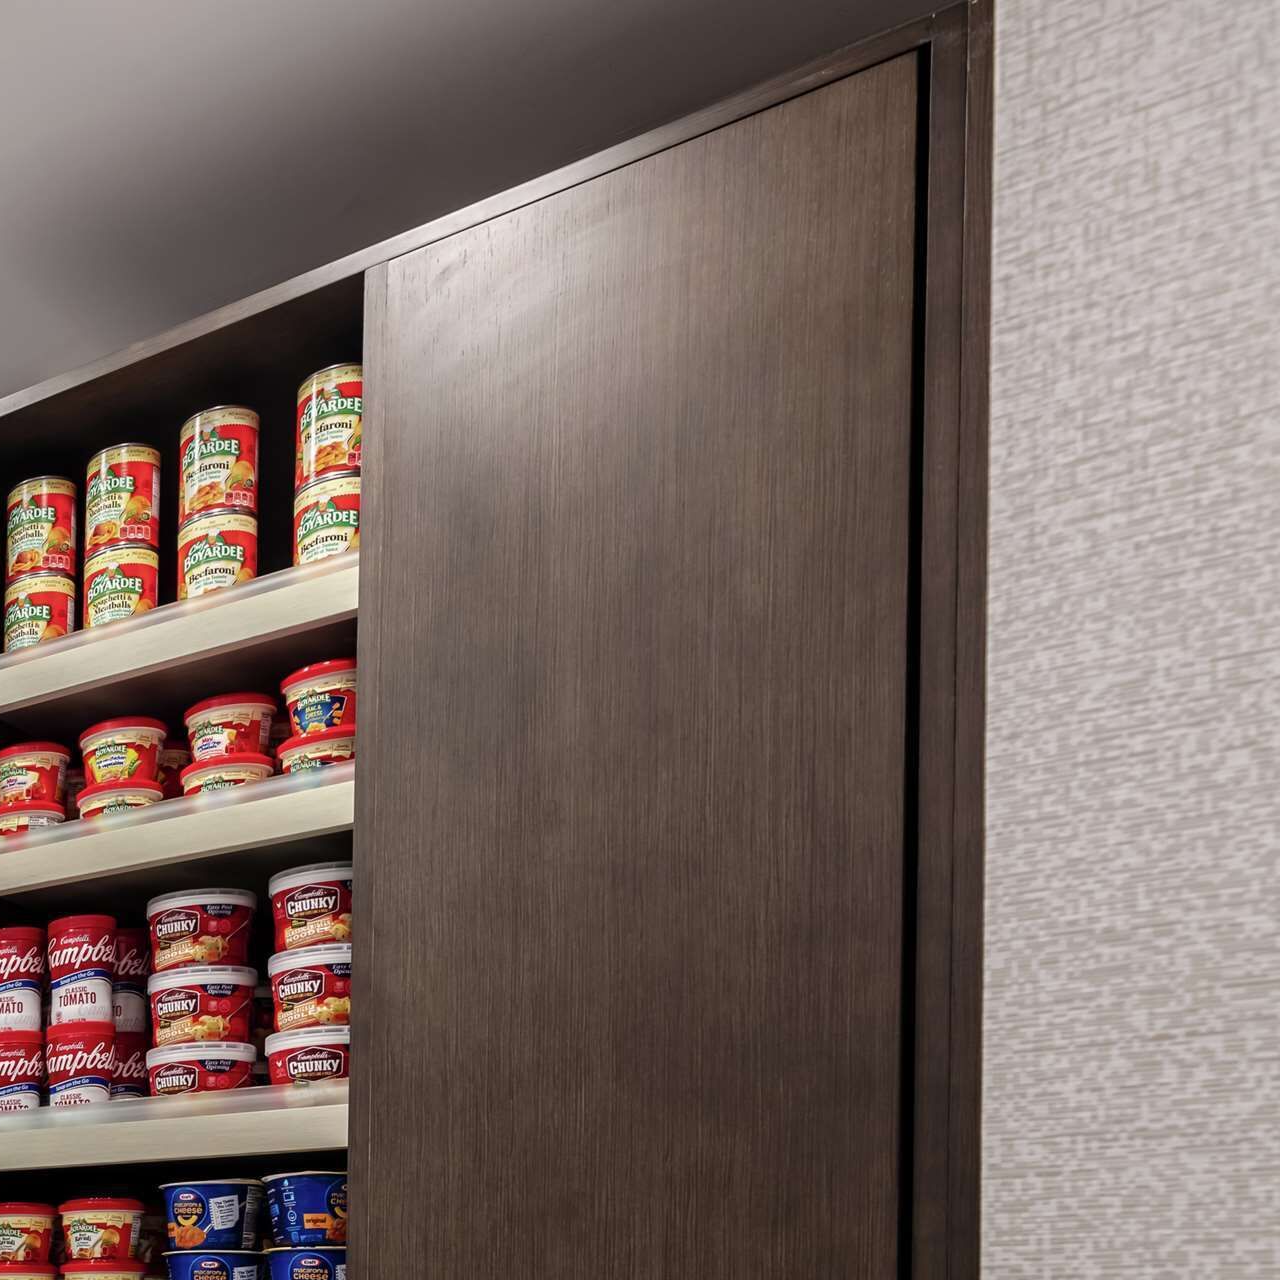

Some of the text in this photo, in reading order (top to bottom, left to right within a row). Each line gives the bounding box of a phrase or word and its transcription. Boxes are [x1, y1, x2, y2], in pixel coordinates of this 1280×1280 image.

[297, 510, 359, 542] BOYARDEE
[301, 532, 348, 556] Beefaroni
[183, 543, 244, 572] BOYARDEE
[188, 565, 236, 585] Beefaroni
[287, 896, 336, 915] CHUNKY
[156, 919, 197, 938] CHUNKY
[64, 986, 88, 995] CLASSIC
[279, 979, 321, 998] CHUNKY
[59, 992, 97, 1007] TOMATO
[157, 998, 197, 1017] CHUNKY
[289, 1059, 340, 1075] CHUNKY
[156, 1073, 195, 1090] CHUNKY
